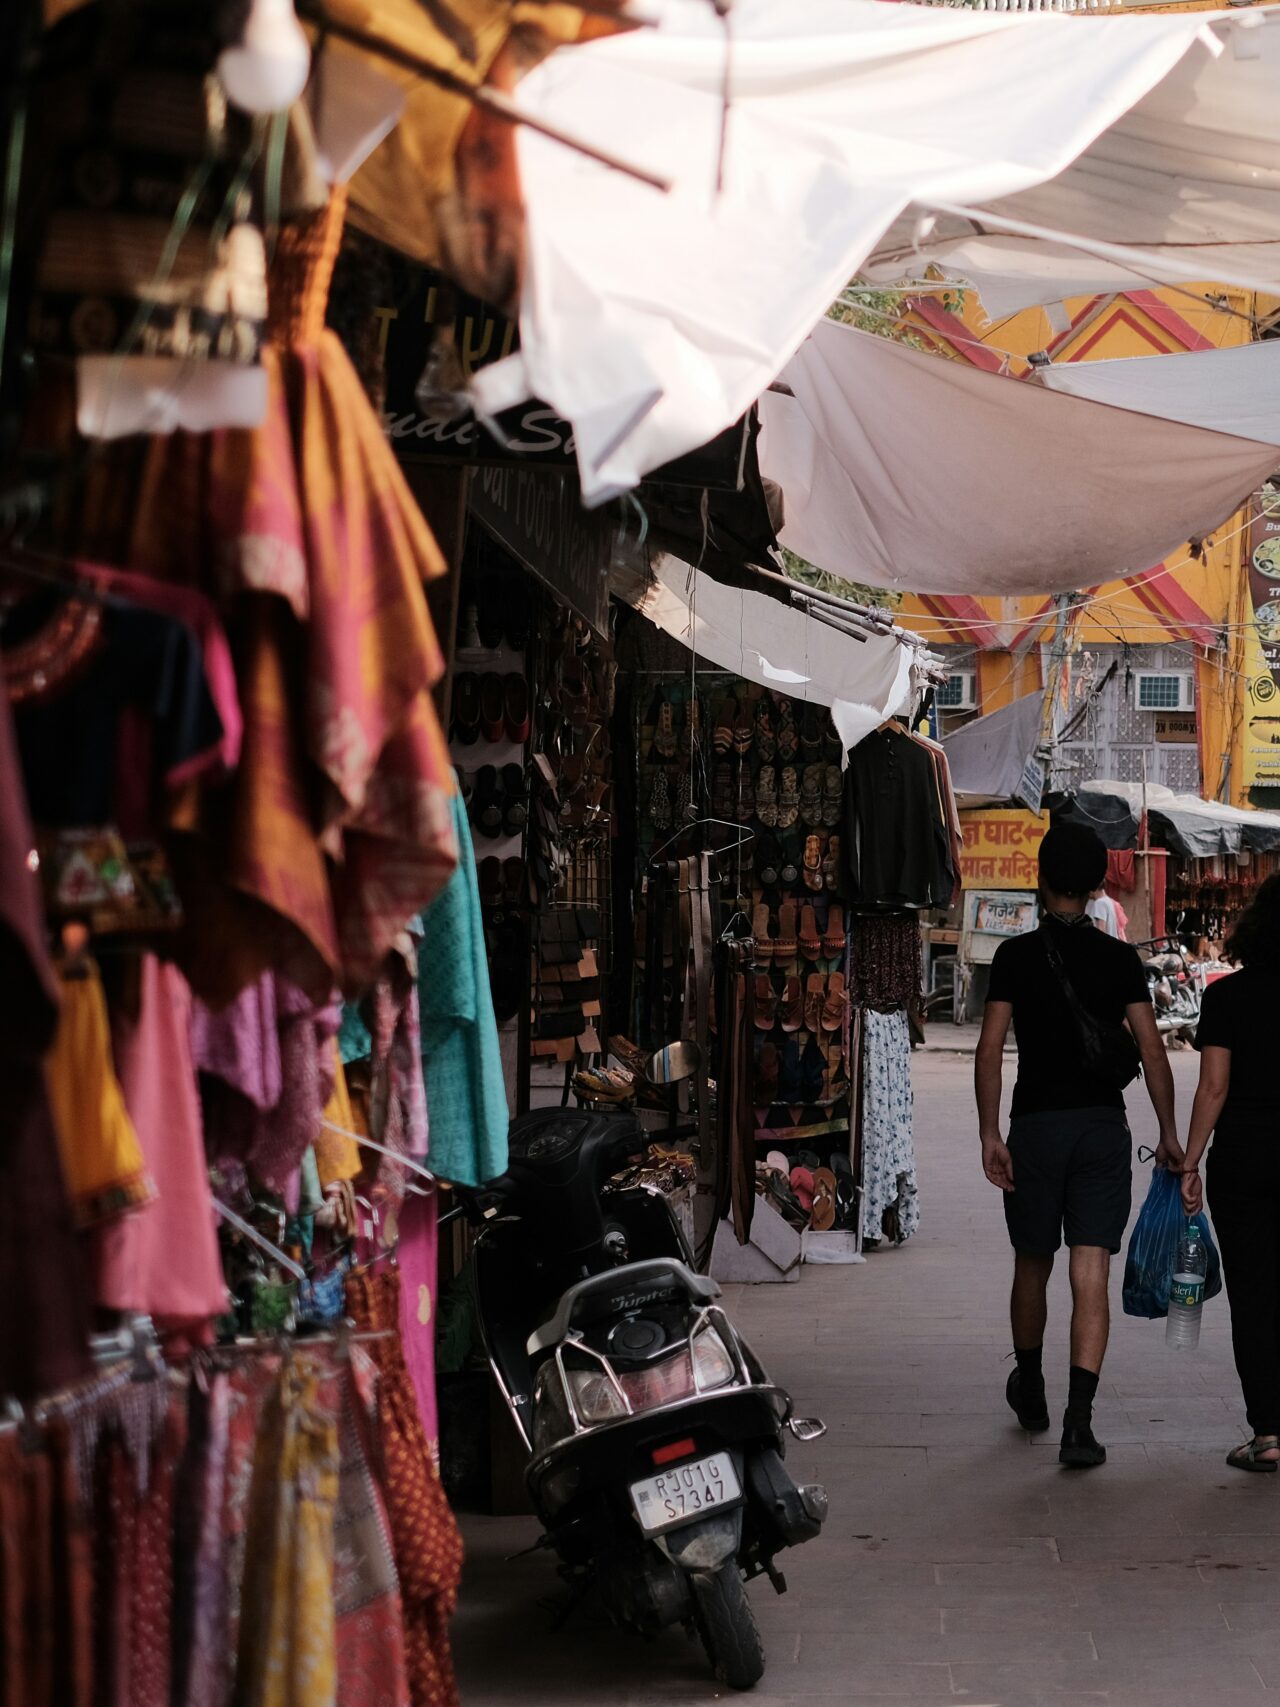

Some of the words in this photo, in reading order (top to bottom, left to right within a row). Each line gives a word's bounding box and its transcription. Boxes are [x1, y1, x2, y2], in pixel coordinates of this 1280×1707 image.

[983, 820, 1024, 846] घाट
[960, 856, 997, 879] मान
[611, 1287, 675, 1312] Jupiter
[1173, 1285, 1193, 1296] sleri
[655, 1458, 721, 1498] RJ01G
[664, 1480, 727, 1520] S7347
